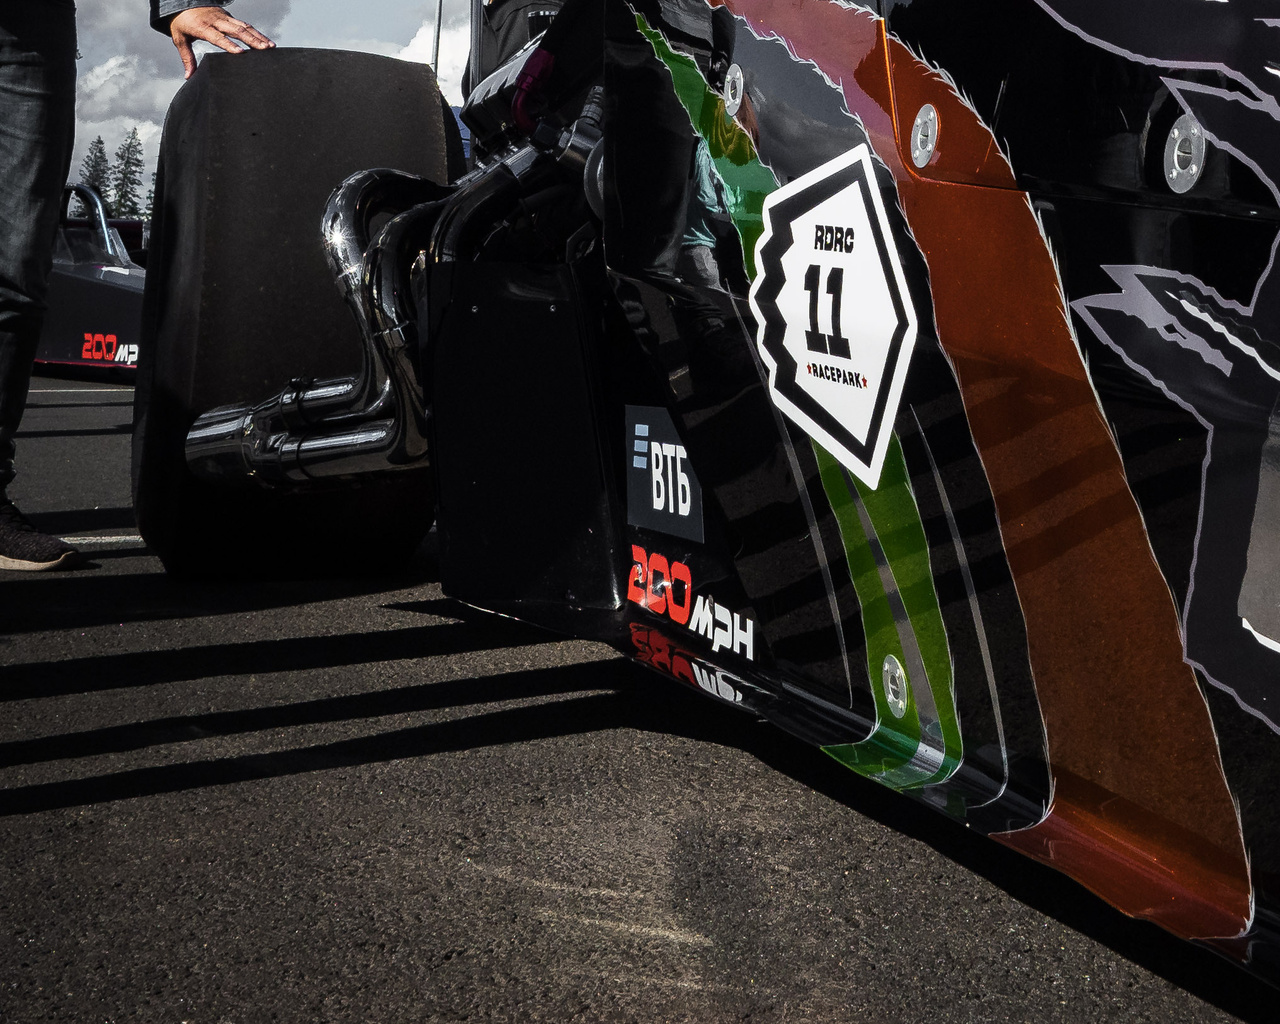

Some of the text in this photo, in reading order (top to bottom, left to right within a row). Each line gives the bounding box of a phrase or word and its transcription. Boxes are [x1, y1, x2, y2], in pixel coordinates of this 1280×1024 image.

[814, 225, 855, 254] RDRC
[804, 264, 852, 360] 11
[812, 362, 862, 389] RACEPARK
[651, 441, 691, 516] ВТБ
